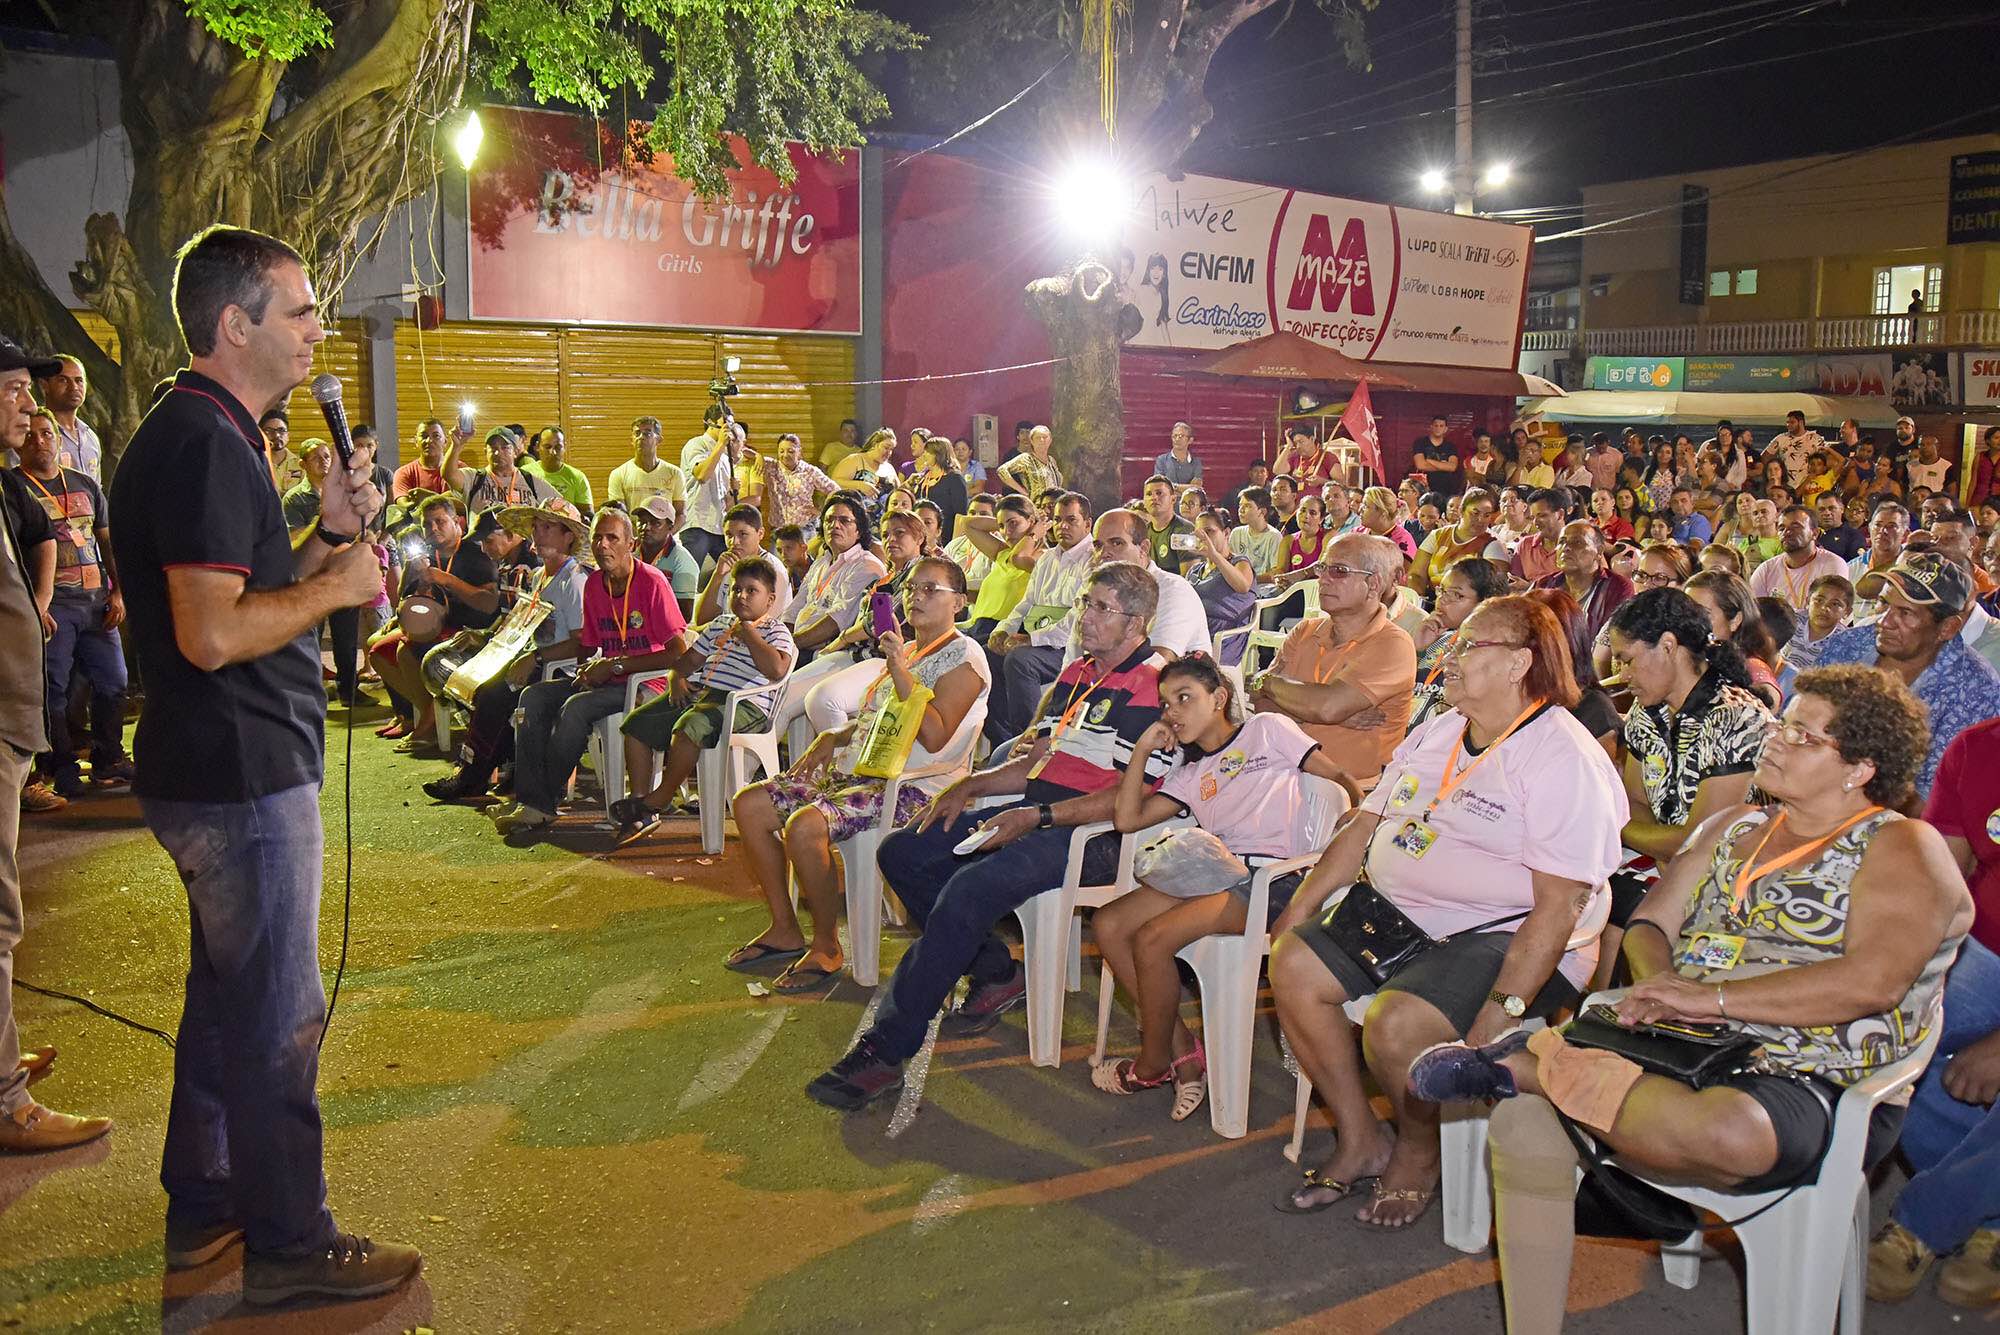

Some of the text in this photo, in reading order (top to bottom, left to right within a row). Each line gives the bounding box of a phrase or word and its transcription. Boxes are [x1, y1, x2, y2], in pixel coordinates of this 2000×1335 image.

[532, 169, 814, 268] Bella Griffe
[656, 252, 704, 275] Girls
[1408, 238, 1437, 253] LUPO
[1439, 241, 1463, 260] SCALA
[1180, 252, 1254, 284] ENFIM
[1298, 247, 1369, 297] MAZÉ
[1431, 285, 1458, 296] LOBA
[1460, 288, 1486, 300] HOPE
[1176, 296, 1266, 328] Carinhoso
